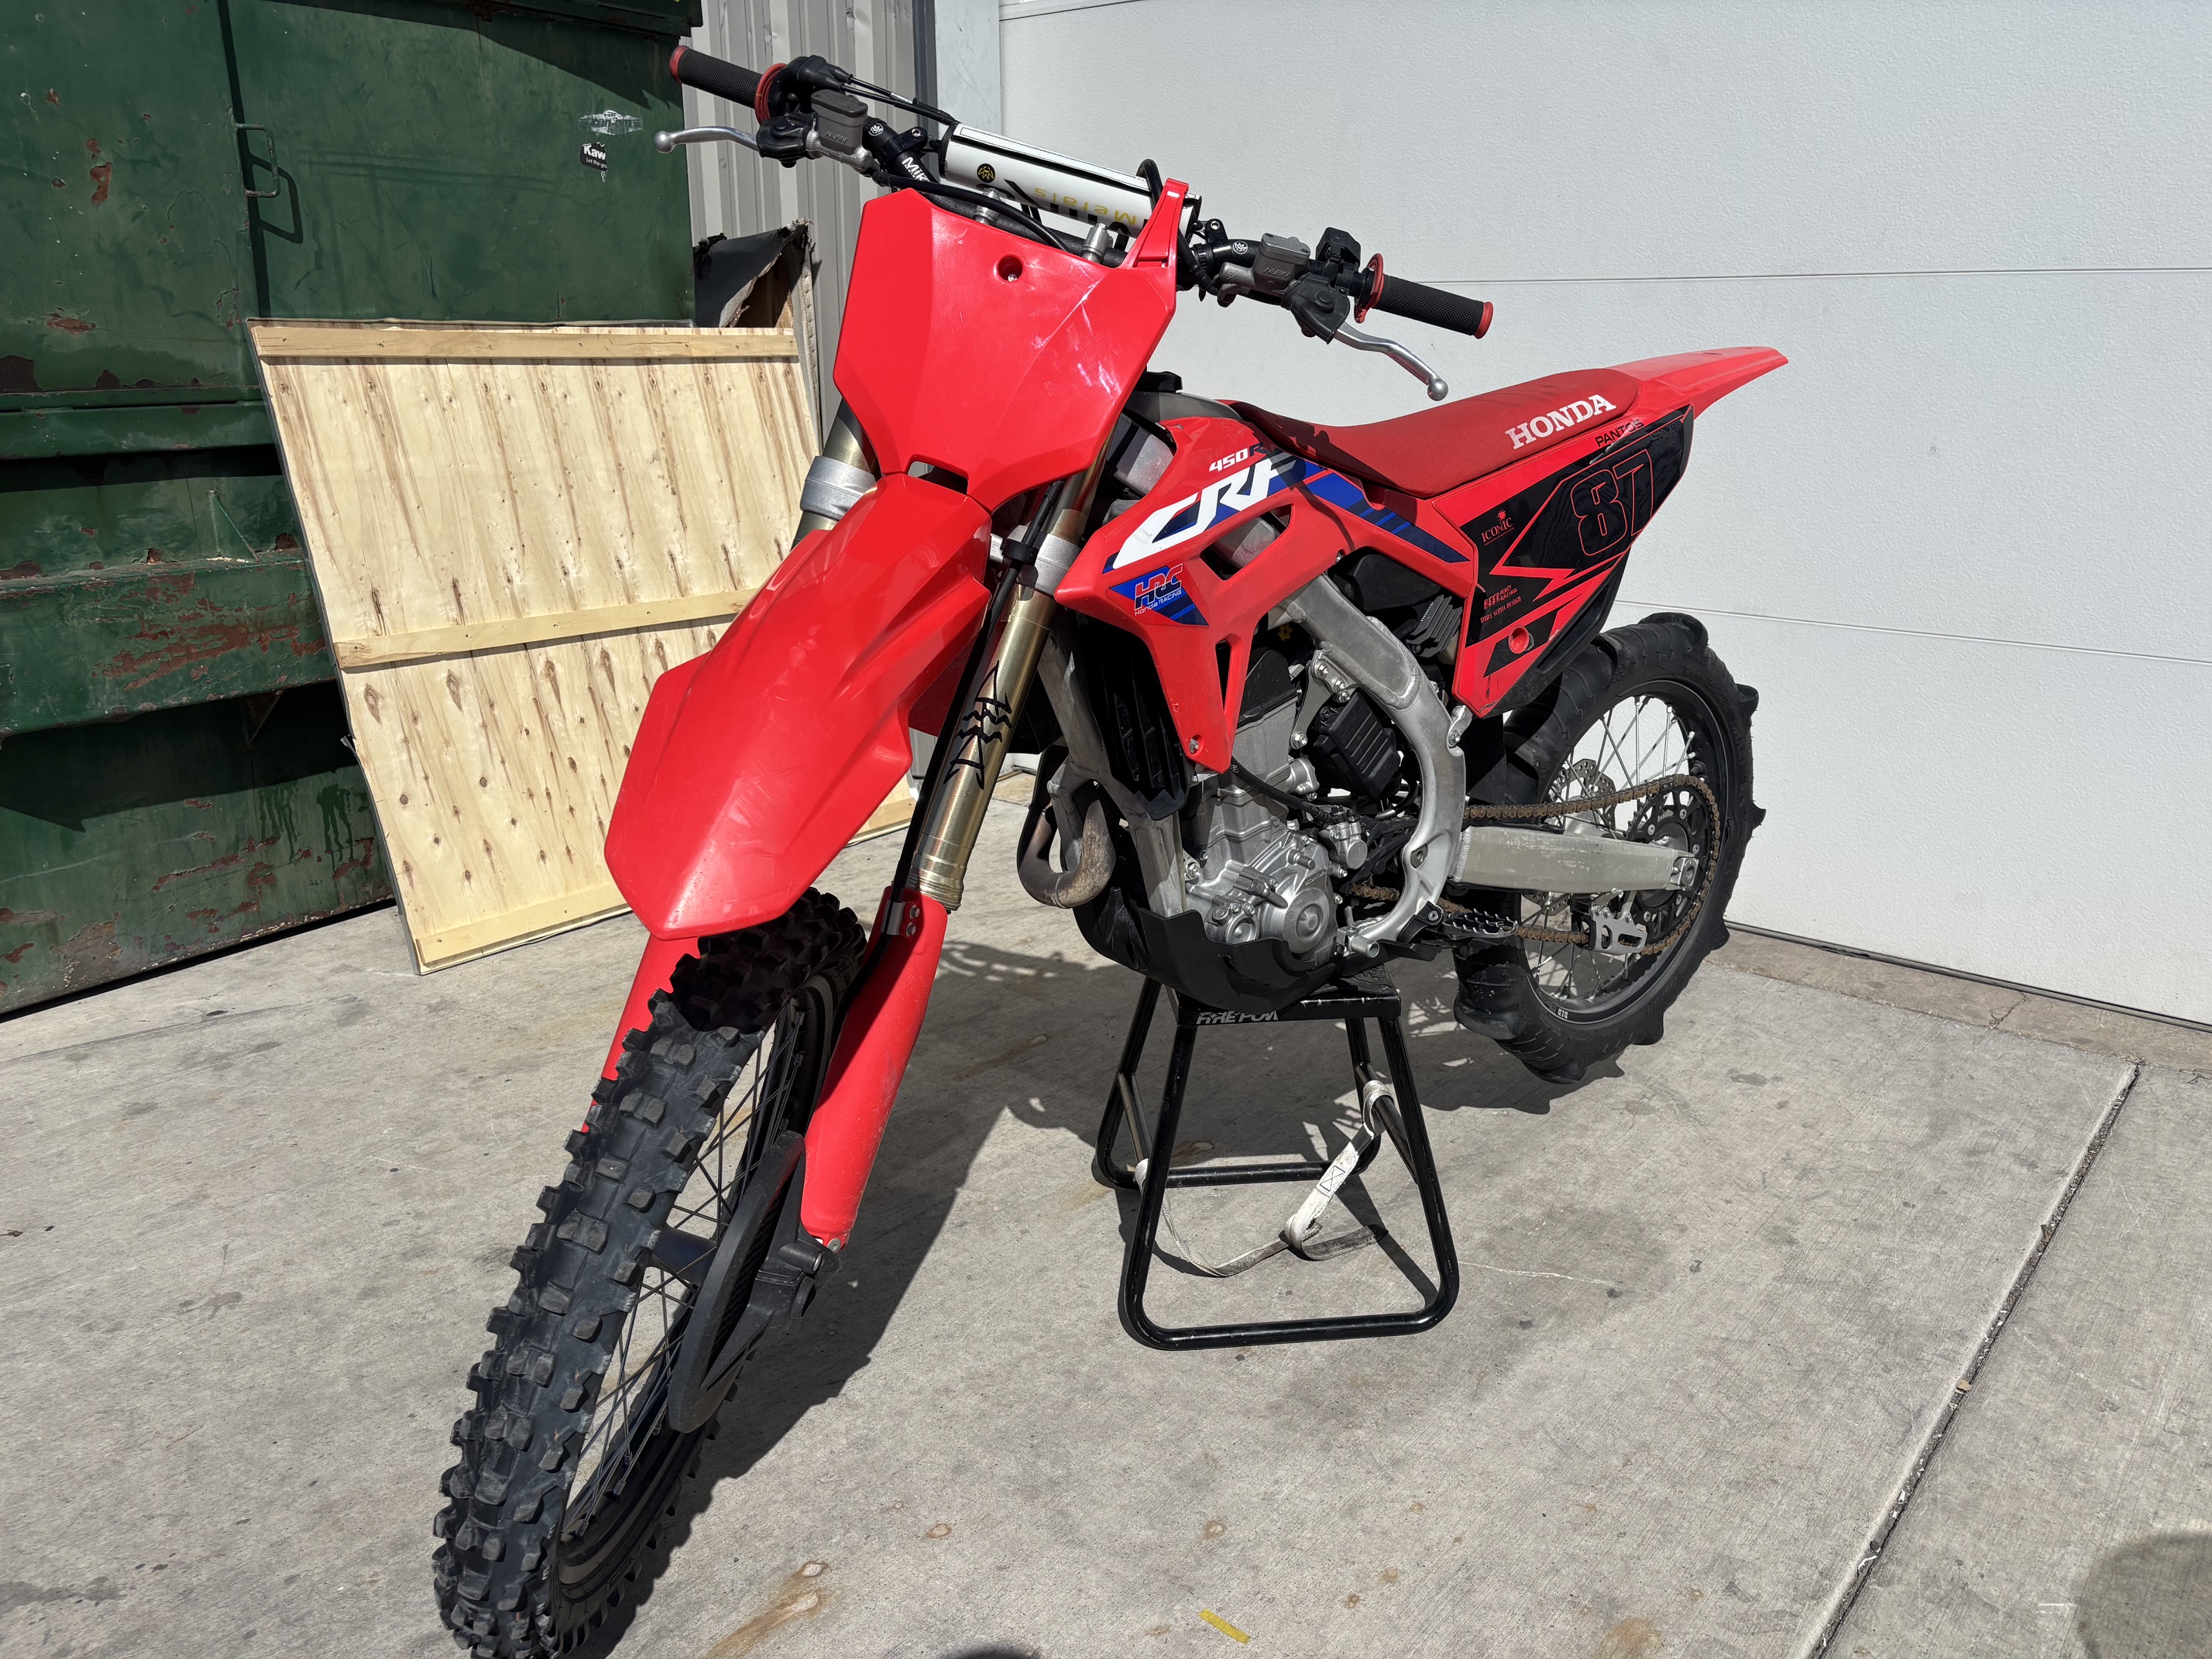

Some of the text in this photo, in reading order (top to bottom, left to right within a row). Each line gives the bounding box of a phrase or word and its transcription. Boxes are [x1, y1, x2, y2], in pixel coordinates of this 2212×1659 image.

[1505, 393, 1616, 450] HONDA
[1112, 451, 1297, 569] CRF
[1570, 449, 1654, 557] 87
[1481, 517, 1513, 542] ICONIC
[1135, 563, 1183, 610] HRC
[1159, 589, 1182, 605] RACING
[1483, 592, 1501, 610] BEER
[1480, 613, 1492, 623] DIRT
